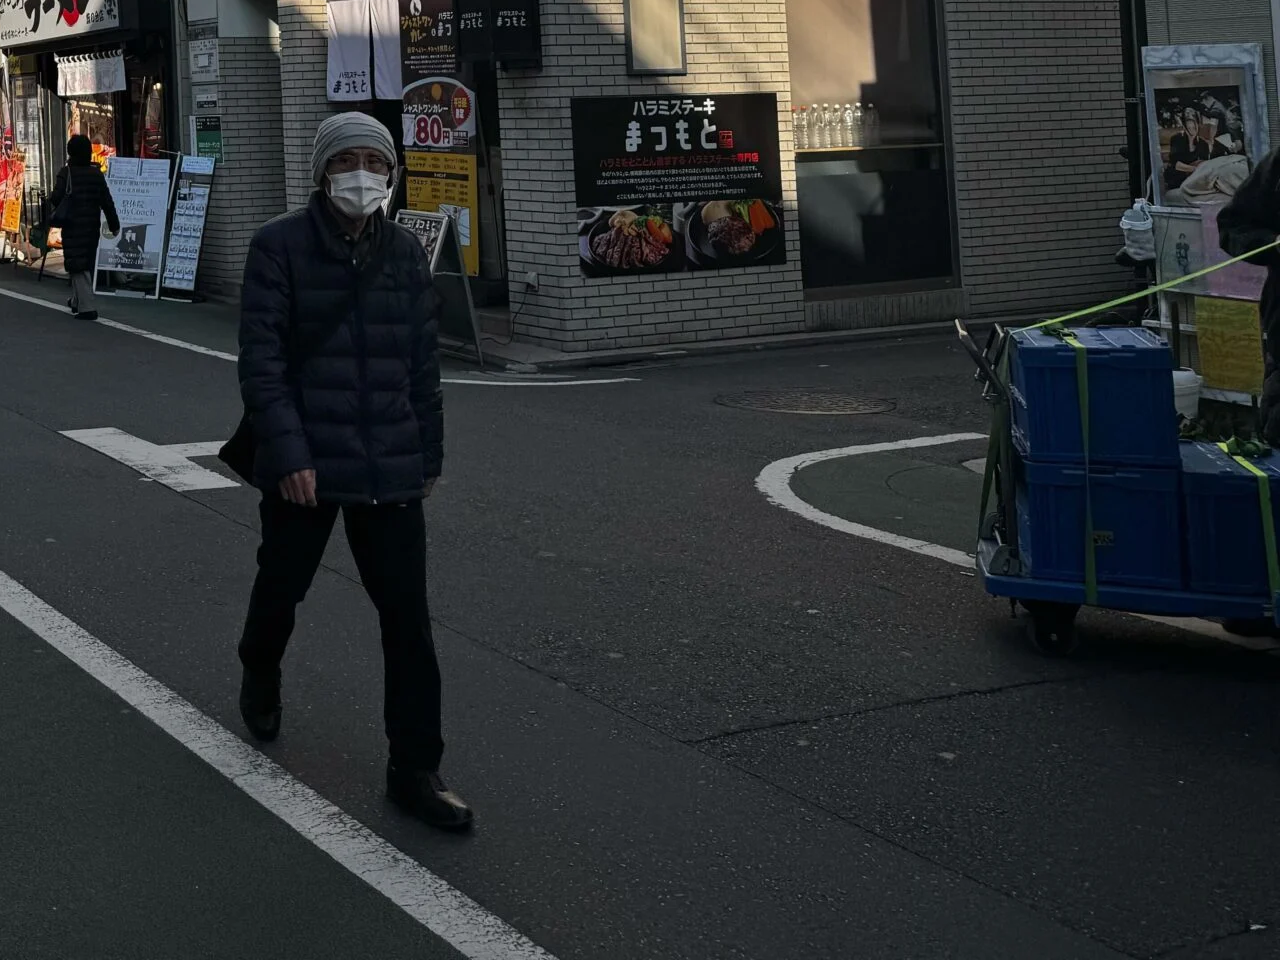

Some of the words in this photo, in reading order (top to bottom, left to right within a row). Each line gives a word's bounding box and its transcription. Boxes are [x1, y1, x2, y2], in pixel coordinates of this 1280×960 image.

[333, 79, 368, 94] まつもと
[632, 97, 716, 116] ハラミステーキ
[625, 118, 718, 153] まつもと
